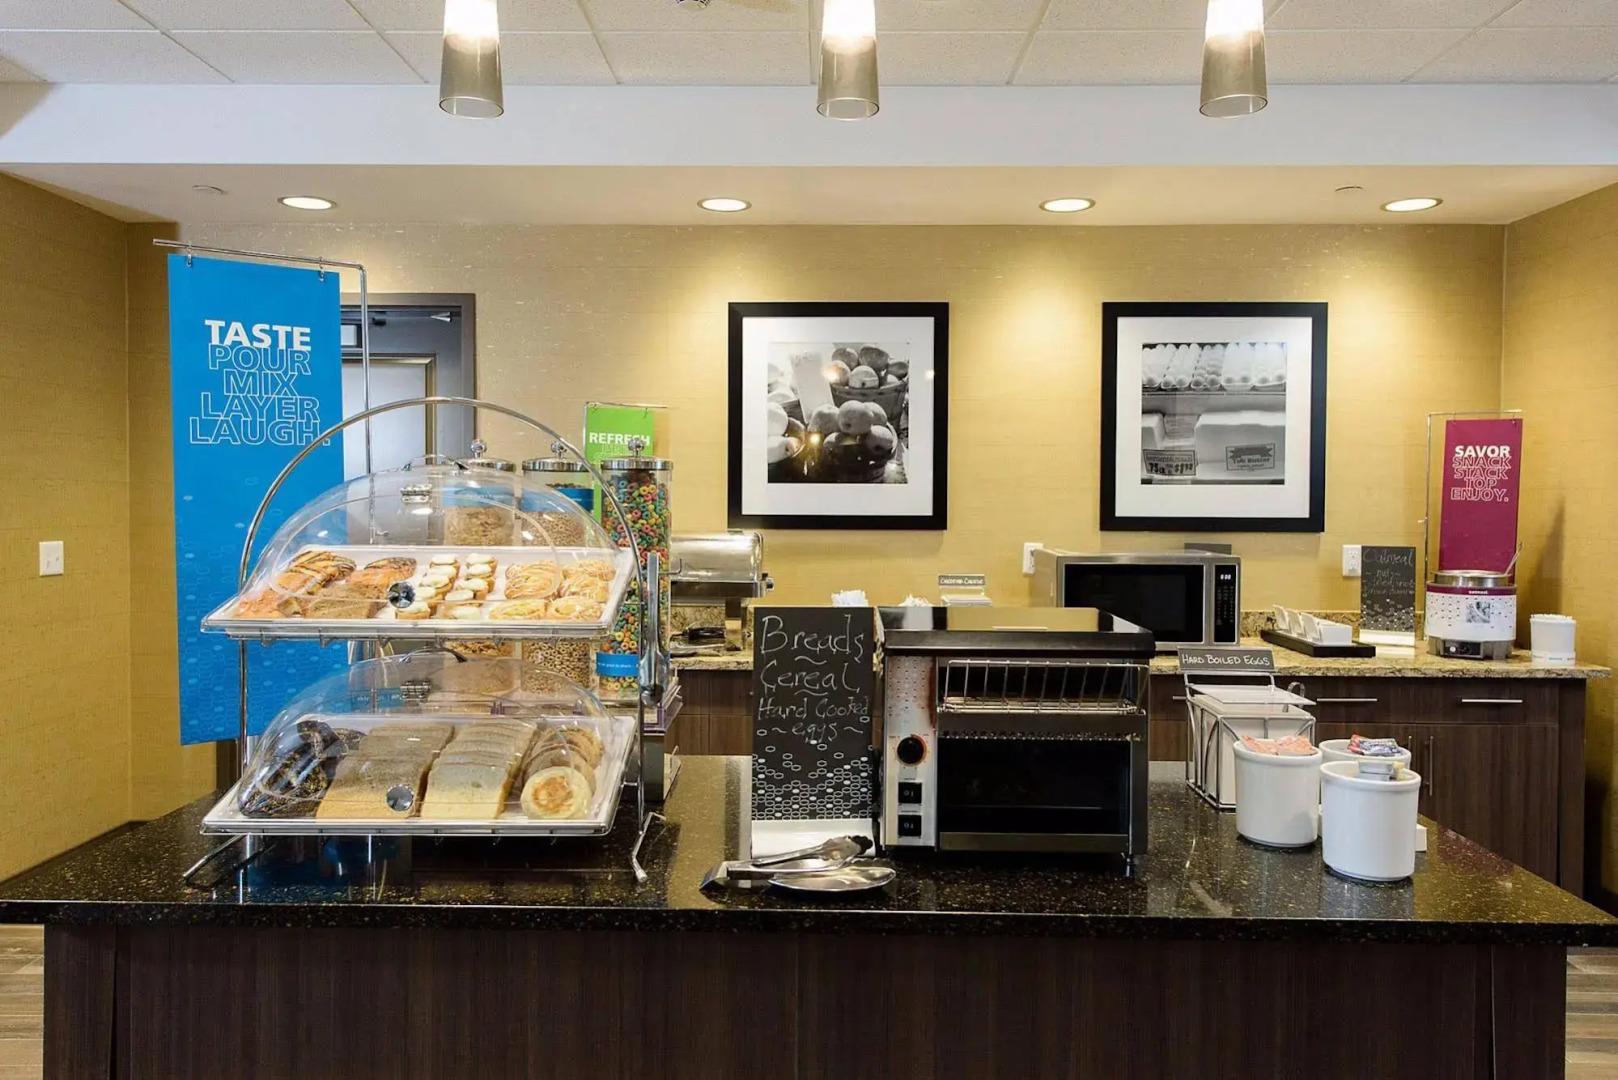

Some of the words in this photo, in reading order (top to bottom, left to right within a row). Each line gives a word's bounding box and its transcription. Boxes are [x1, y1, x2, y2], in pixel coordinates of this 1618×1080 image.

[204, 319, 311, 351] TASTE
[208, 343, 311, 375] POUR
[224, 368, 299, 397] MIX
[201, 392, 320, 422] LAYER
[189, 416, 331, 446] LAUGH.
[1452, 455, 1512, 469] SNACK
[1454, 445, 1511, 458] SAVOR
[1453, 467, 1509, 480] STACK
[1463, 477, 1498, 490] TOP
[1450, 487, 1510, 502] ENJOY.
[760, 614, 864, 663] Breads
[1181, 653, 1205, 664] HARD
[1205, 654, 1241, 665] BOILED
[1243, 655, 1270, 666] EGGS
[760, 659, 860, 694] Cereal
[758, 697, 807, 720] Hard
